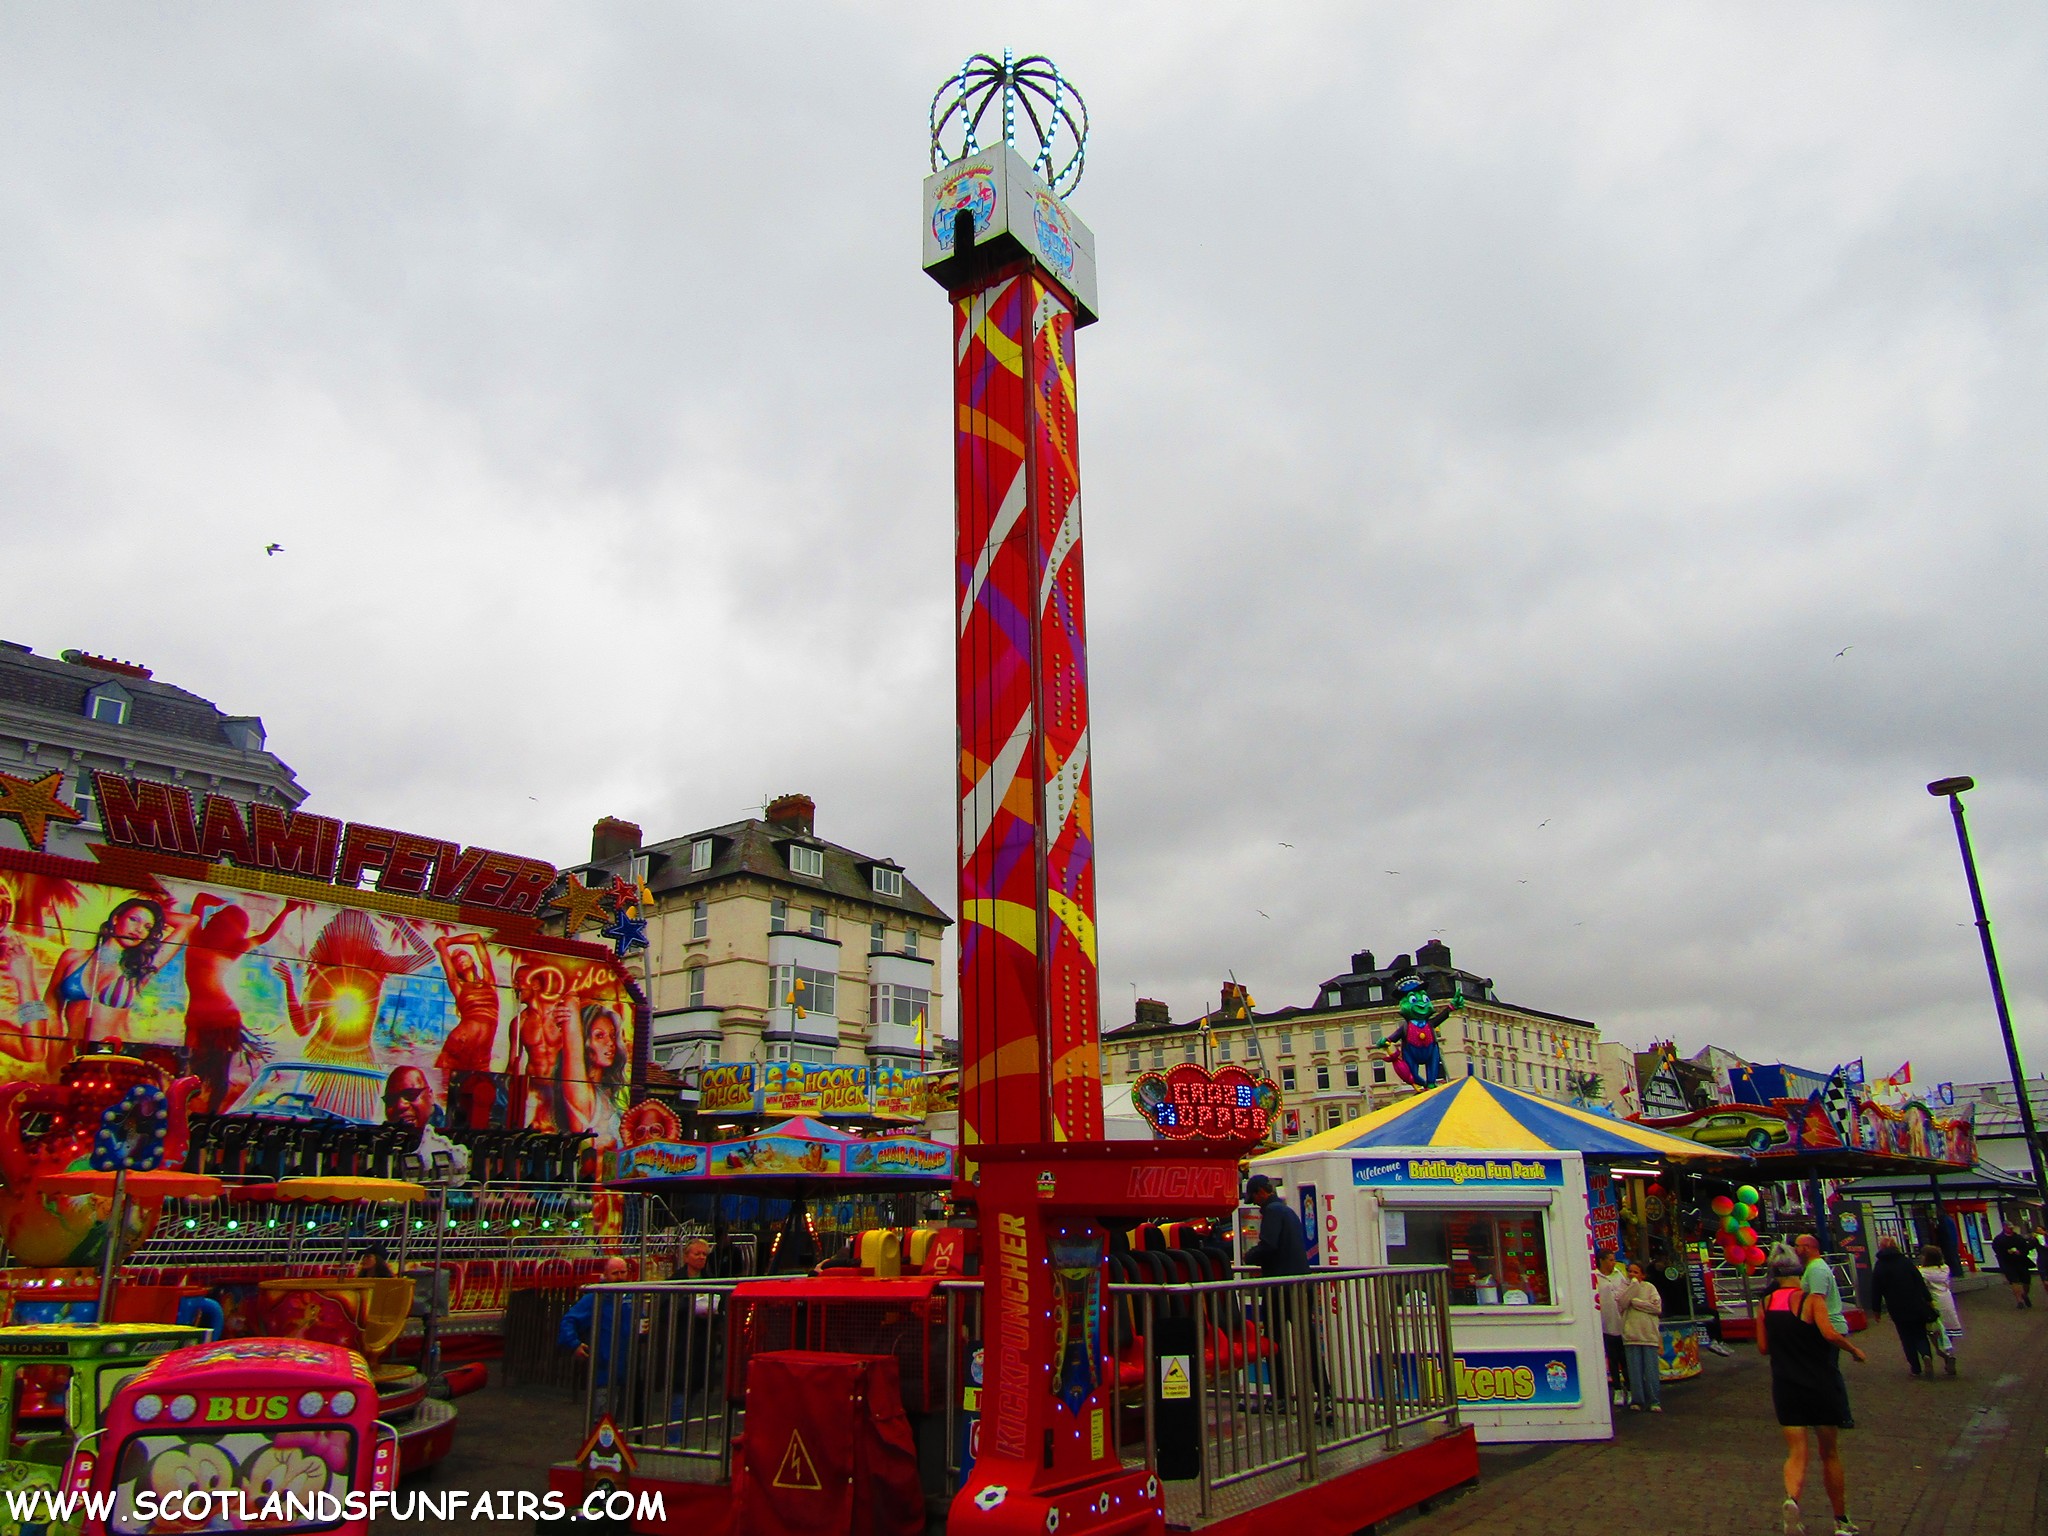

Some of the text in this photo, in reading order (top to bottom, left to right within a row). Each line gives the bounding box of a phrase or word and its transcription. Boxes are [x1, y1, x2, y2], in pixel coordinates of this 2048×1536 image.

[938, 209, 990, 250] PK
[91, 768, 559, 916] MIAMI FEVER
[702, 1065, 752, 1092] OOK A
[804, 1067, 867, 1093] HOOK A
[705, 1082, 752, 1110] DUCK
[821, 1084, 867, 1110] DUCK
[878, 1145, 947, 1170] CHAIR-O-PLANES
[1356, 1161, 1401, 1181] Welcome
[1395, 1172, 1402, 1181] to
[1408, 1160, 1547, 1185] Bridlington Fun Park
[1590, 1174, 1609, 1190] WIN
[1599, 1188, 1607, 1206] A
[1592, 1204, 1617, 1222] PRIZE
[1594, 1221, 1618, 1240] EVERY
[995, 1213, 1030, 1459] KICKPUNCHER
[205, 1396, 289, 1421] BUS
[375, 1449, 388, 1491] BUS
